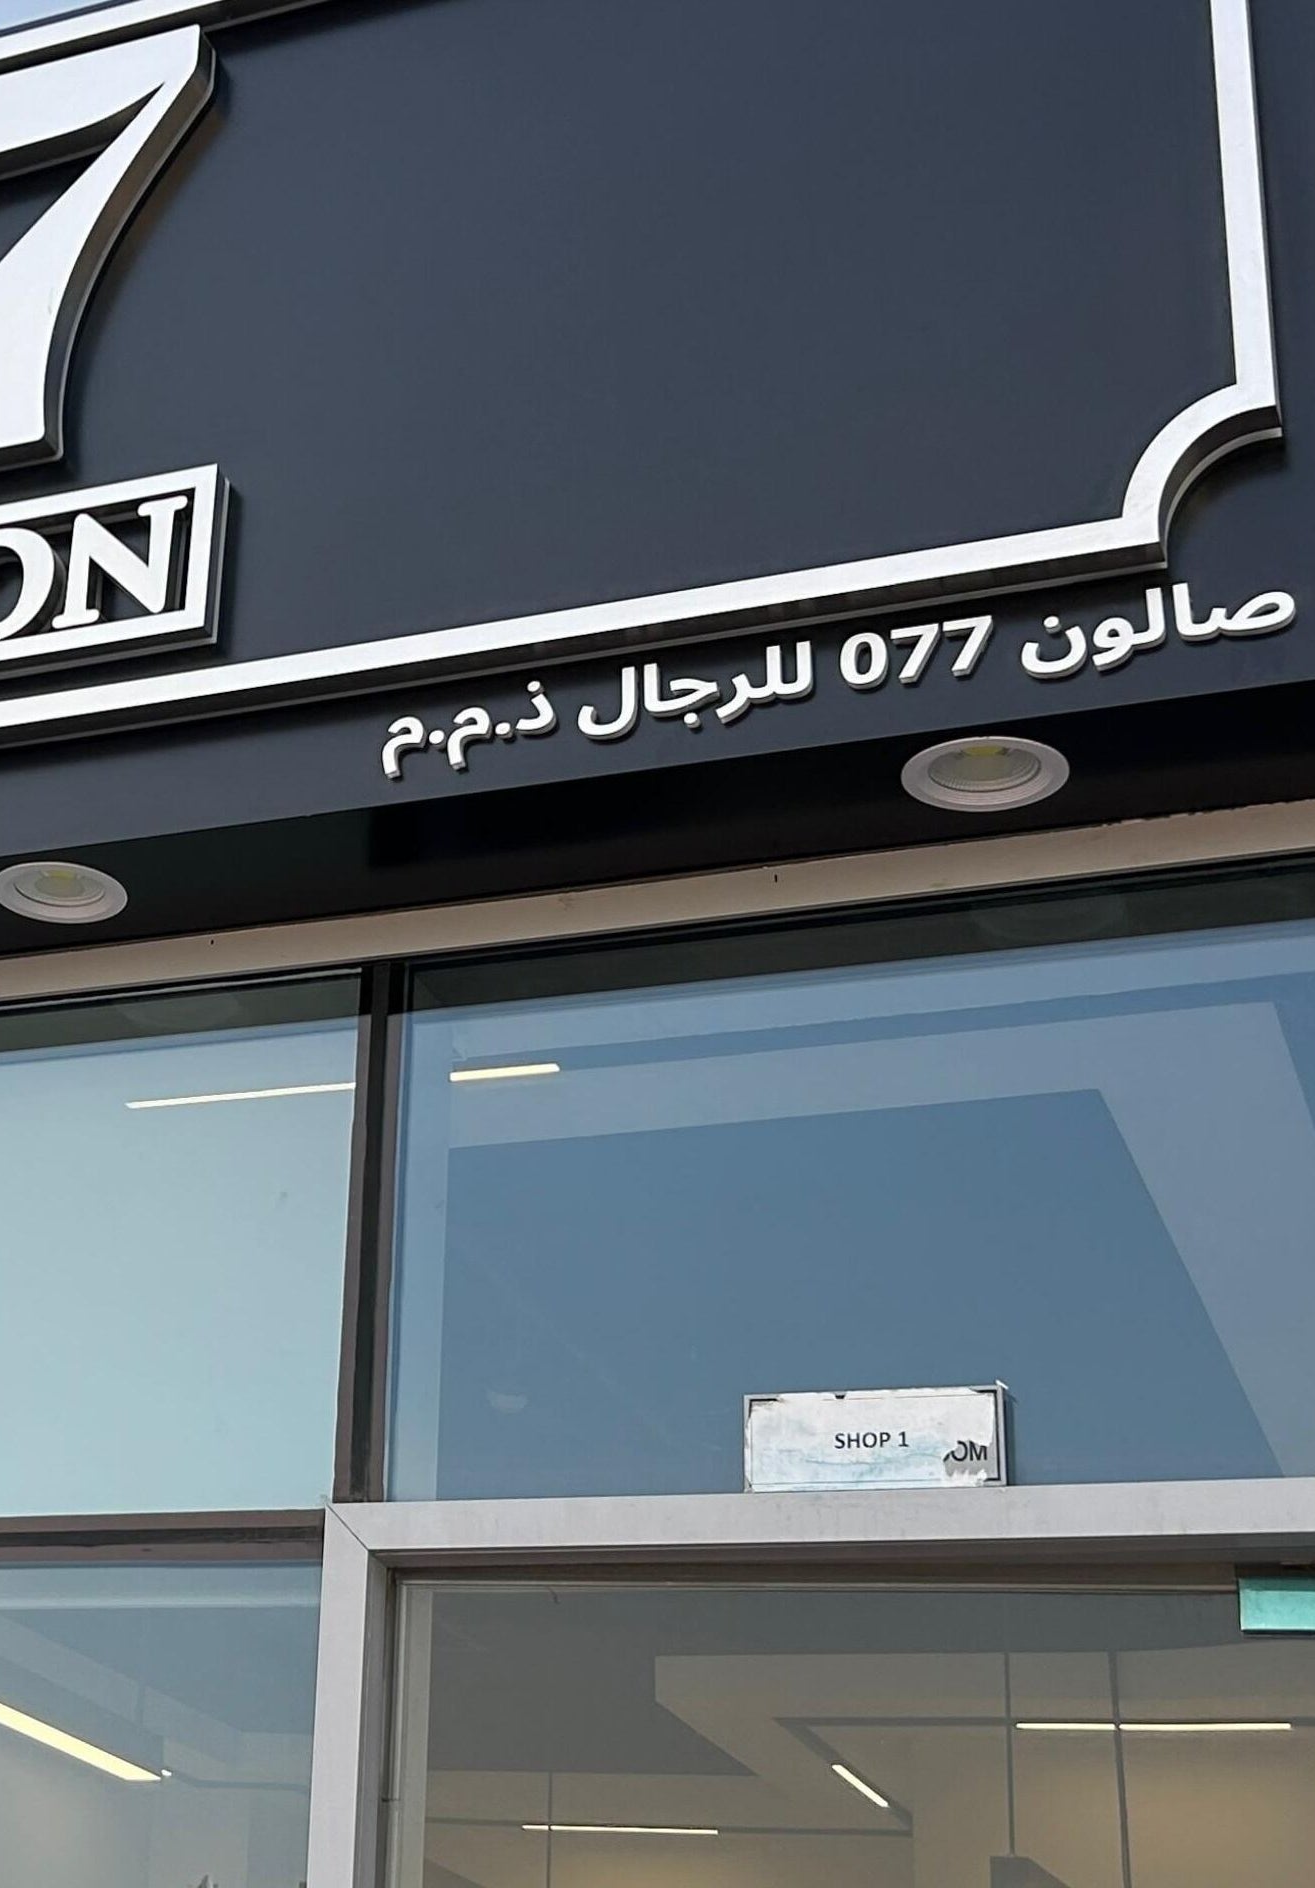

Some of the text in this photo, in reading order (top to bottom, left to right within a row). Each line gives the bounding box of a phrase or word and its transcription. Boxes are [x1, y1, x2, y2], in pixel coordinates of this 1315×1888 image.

[839, 615, 993, 691] 077
[1020, 581, 1297, 681] صالون
[577, 640, 812, 741] للرجال
[834, 1431, 910, 1450] SHOP 1
[943, 1440, 988, 1462] OM
